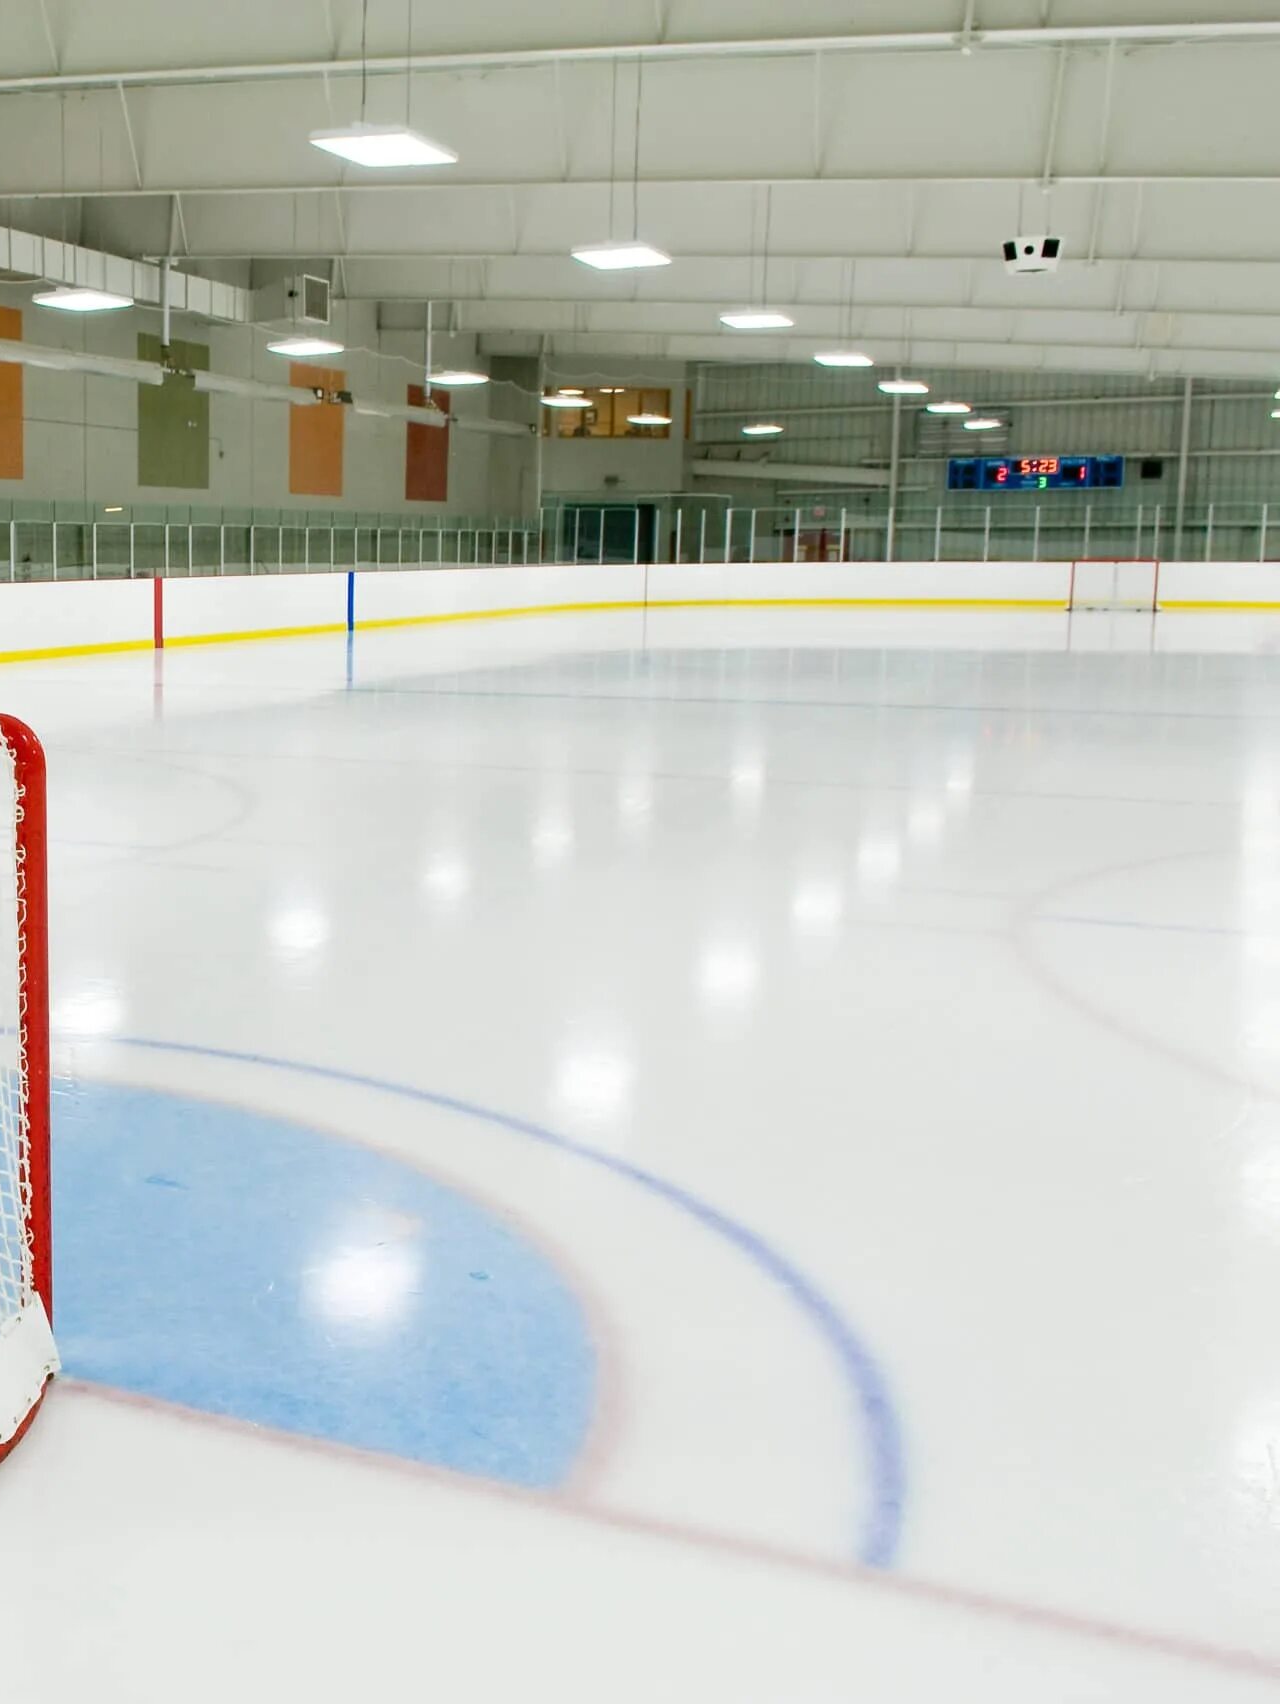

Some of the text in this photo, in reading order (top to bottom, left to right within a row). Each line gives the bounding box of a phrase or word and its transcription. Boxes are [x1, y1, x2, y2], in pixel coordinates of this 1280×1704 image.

[1021, 459, 1057, 473] 5:23
[1079, 466, 1086, 480] 1
[997, 467, 1008, 482] 2
[1038, 476, 1047, 489] 3
